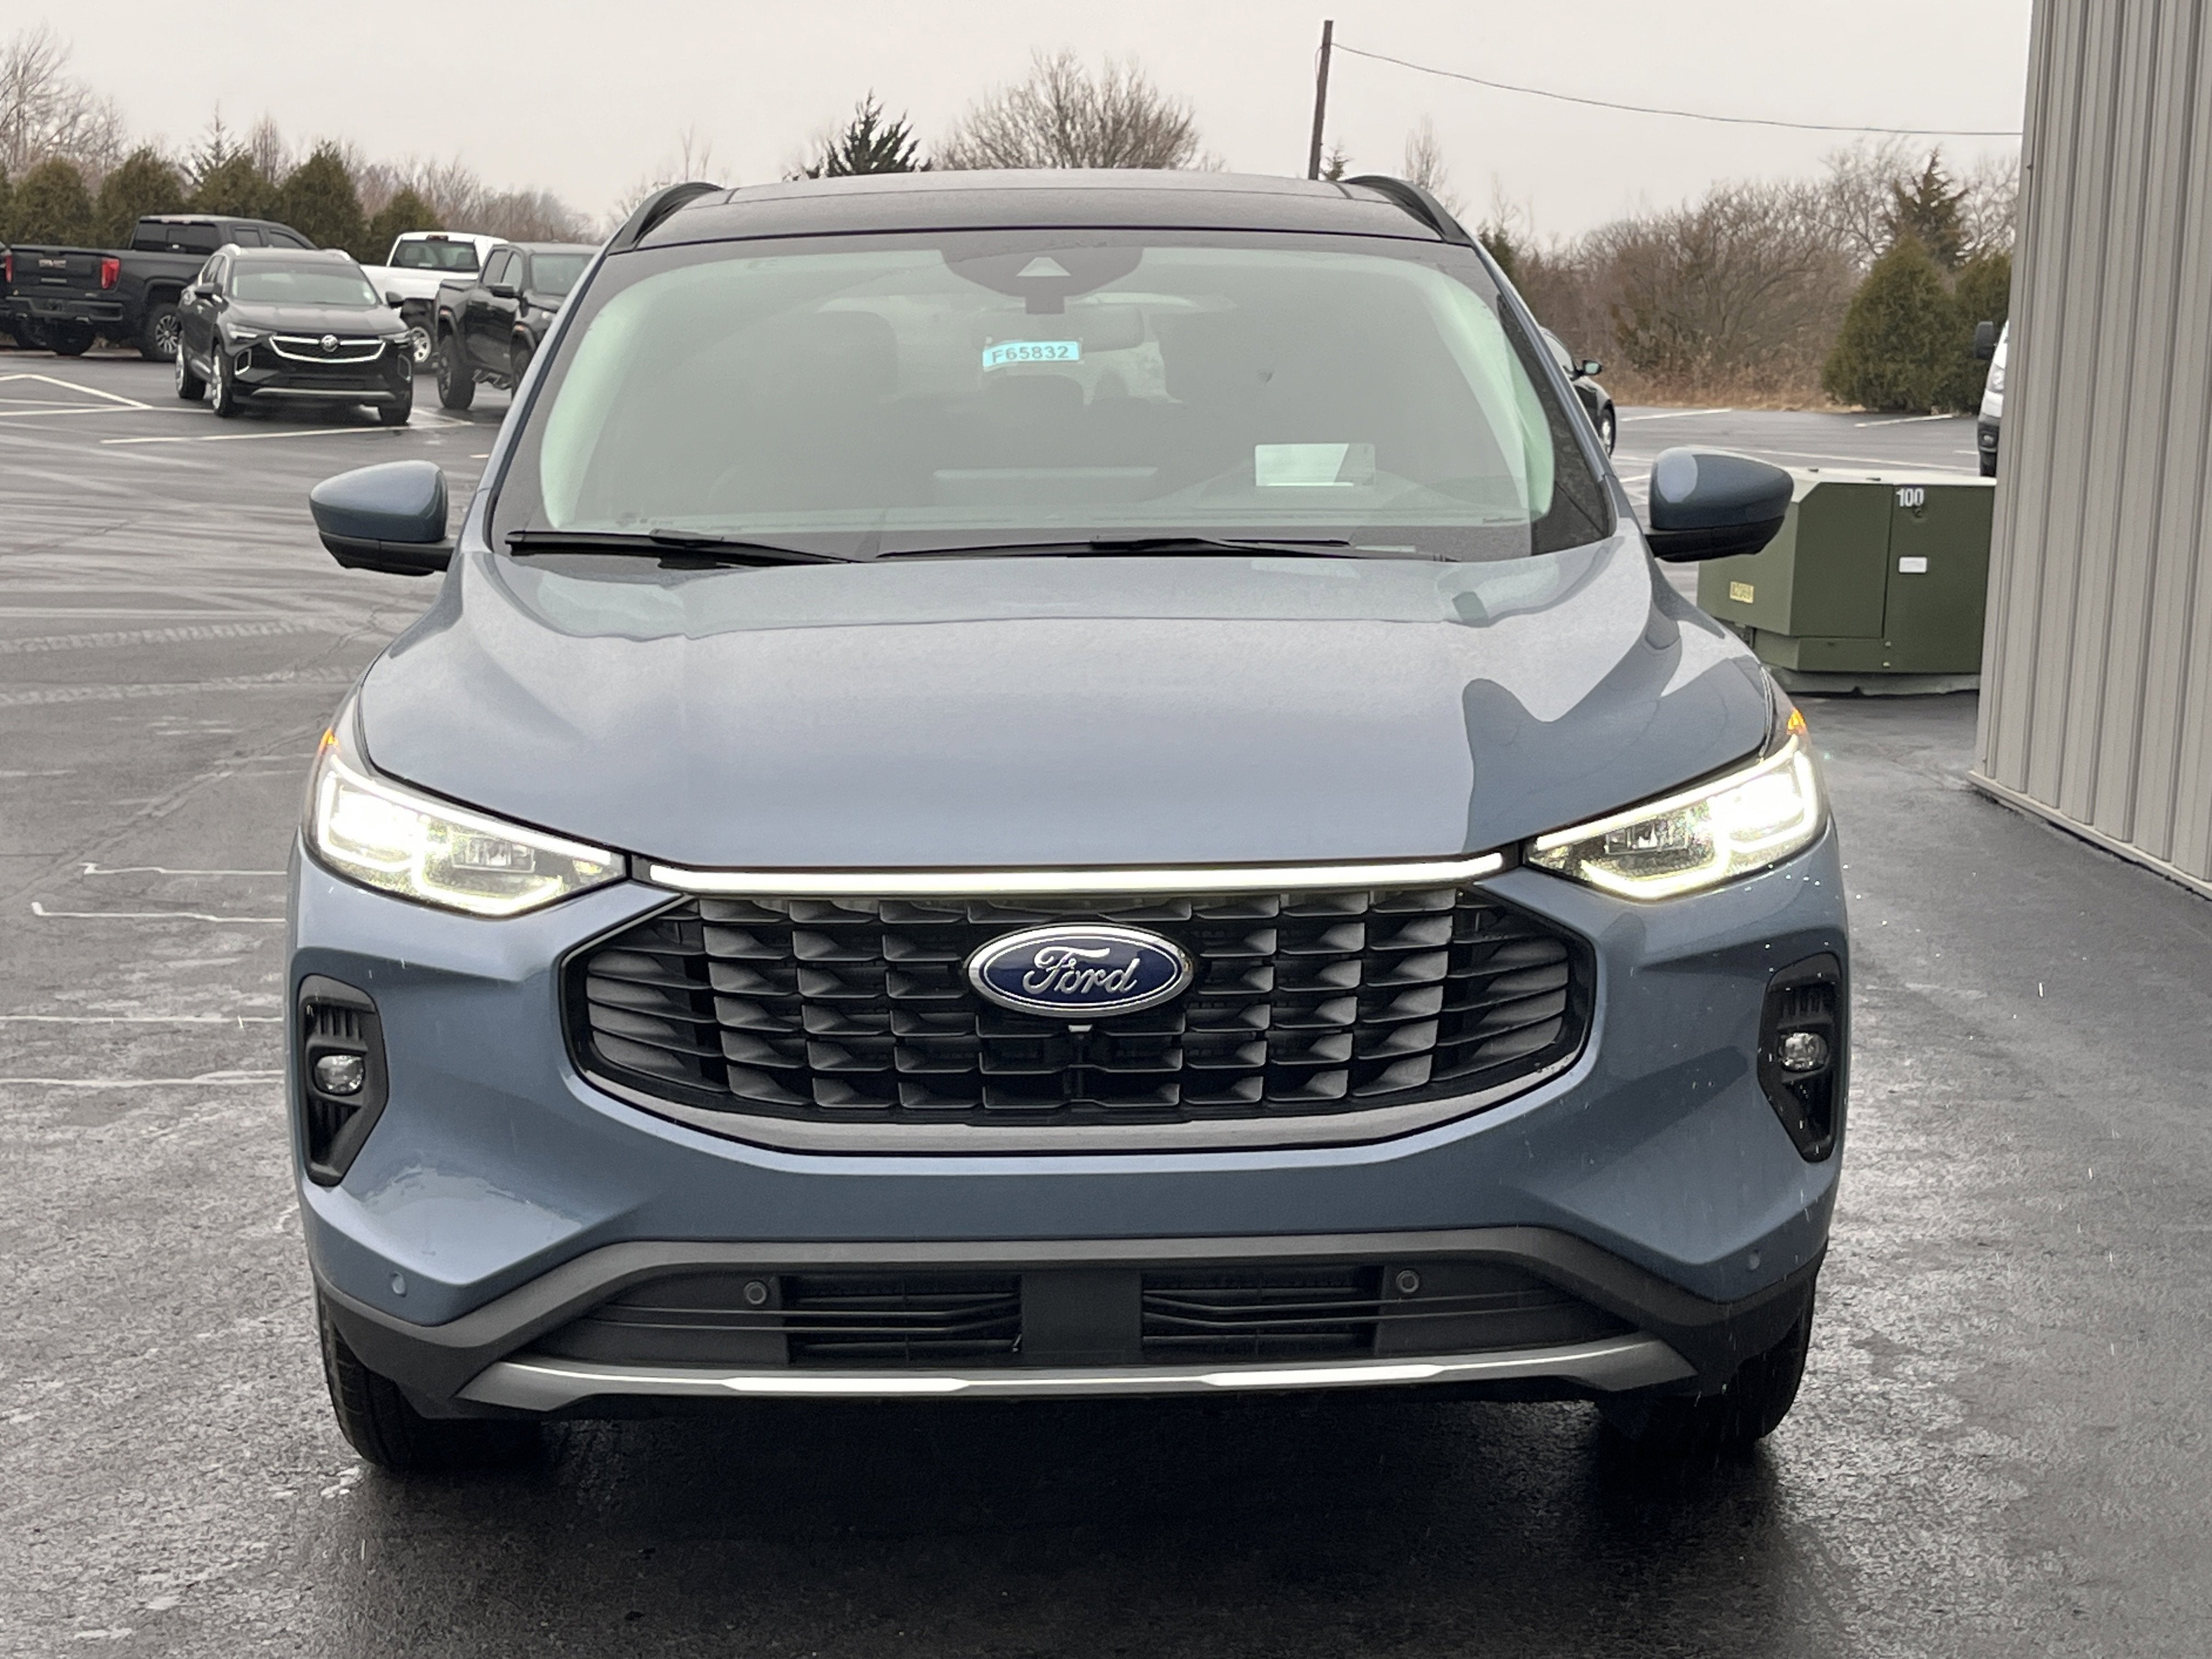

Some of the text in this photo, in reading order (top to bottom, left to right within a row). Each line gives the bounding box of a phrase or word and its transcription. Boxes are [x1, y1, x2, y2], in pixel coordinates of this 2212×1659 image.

[991, 346, 1069, 363] F65832
[1896, 488, 1924, 507] 100
[1023, 946, 1141, 995] Ford
